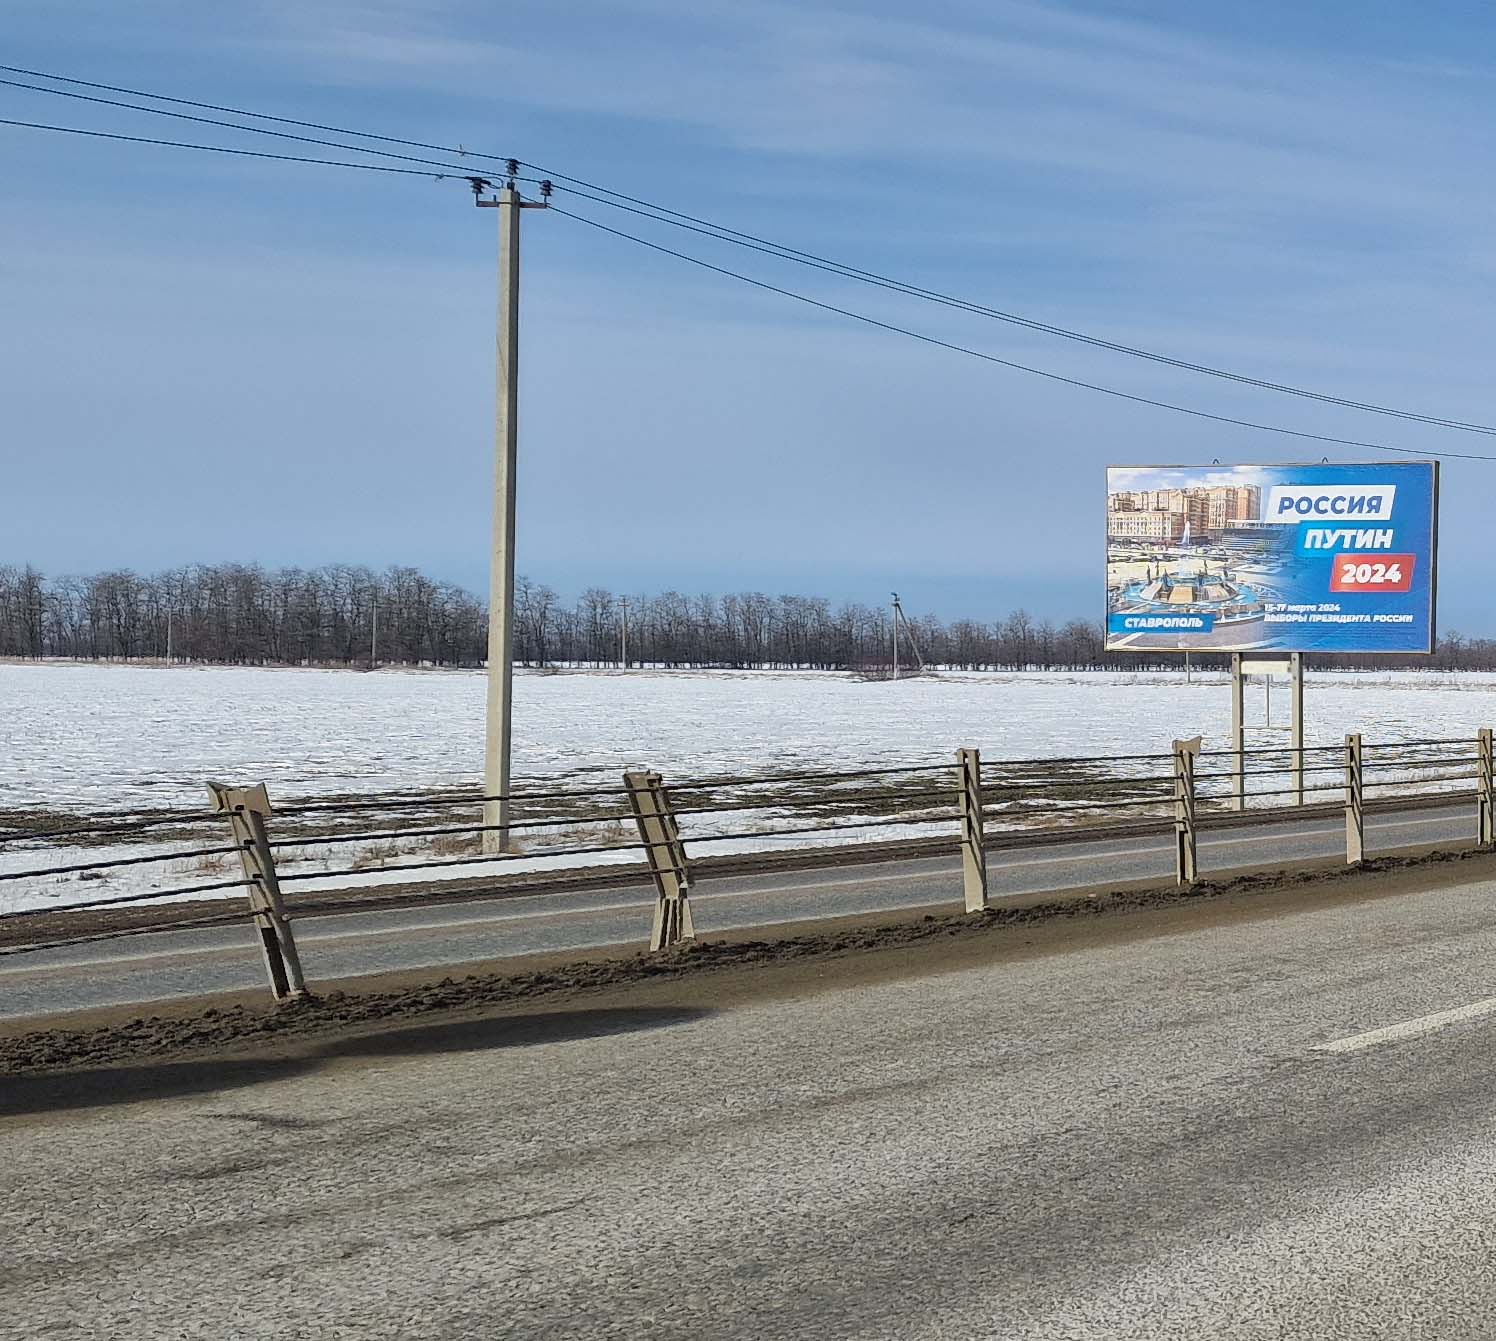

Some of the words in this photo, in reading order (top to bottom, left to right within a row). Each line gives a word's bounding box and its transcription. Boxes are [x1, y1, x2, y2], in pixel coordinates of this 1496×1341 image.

[1278, 496, 1383, 515] РОССИЯ
[1303, 529, 1394, 549] ПУТИН
[1340, 563, 1402, 584] 2024
[1287, 604, 1317, 613] марта
[1318, 603, 1341, 612] 2024
[1124, 617, 1204, 629] СТАВРОПОЛЬ
[1263, 614, 1307, 623] ВЫБОРЫ
[1308, 614, 1371, 624] ПРЕЗИДЕНТА
[1372, 614, 1414, 623] РОССИИ
